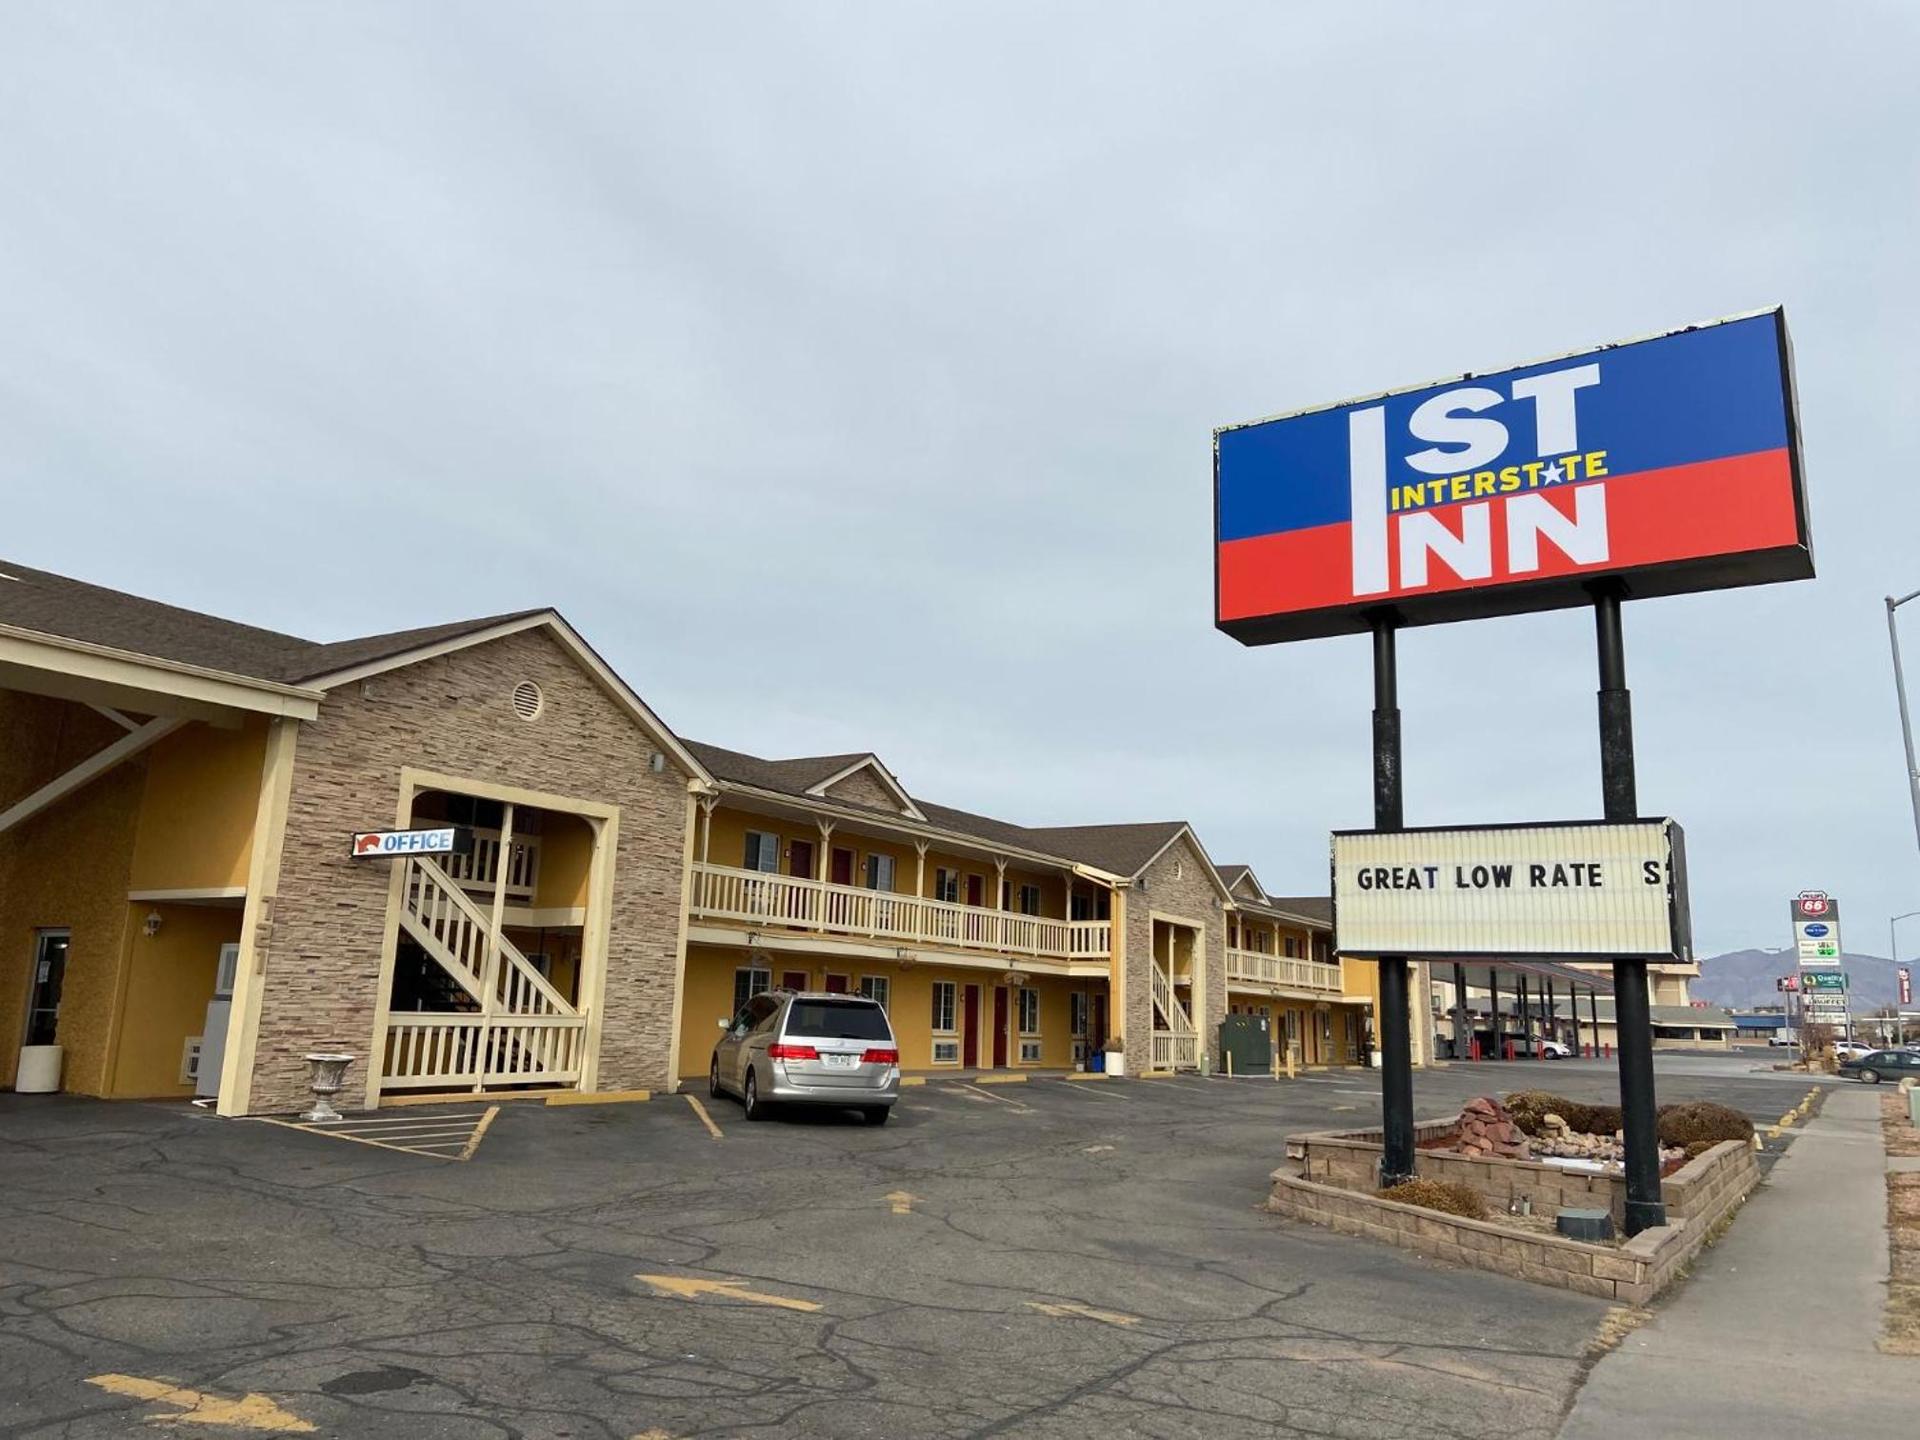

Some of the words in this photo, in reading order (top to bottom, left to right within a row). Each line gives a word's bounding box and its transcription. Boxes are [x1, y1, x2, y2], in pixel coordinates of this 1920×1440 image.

[384, 834, 450, 851] OFFICE
[1357, 867, 1438, 890] GREAT
[1456, 865, 1513, 889] LOW
[1529, 863, 1602, 888] RATE
[1804, 900, 1823, 911] 66
